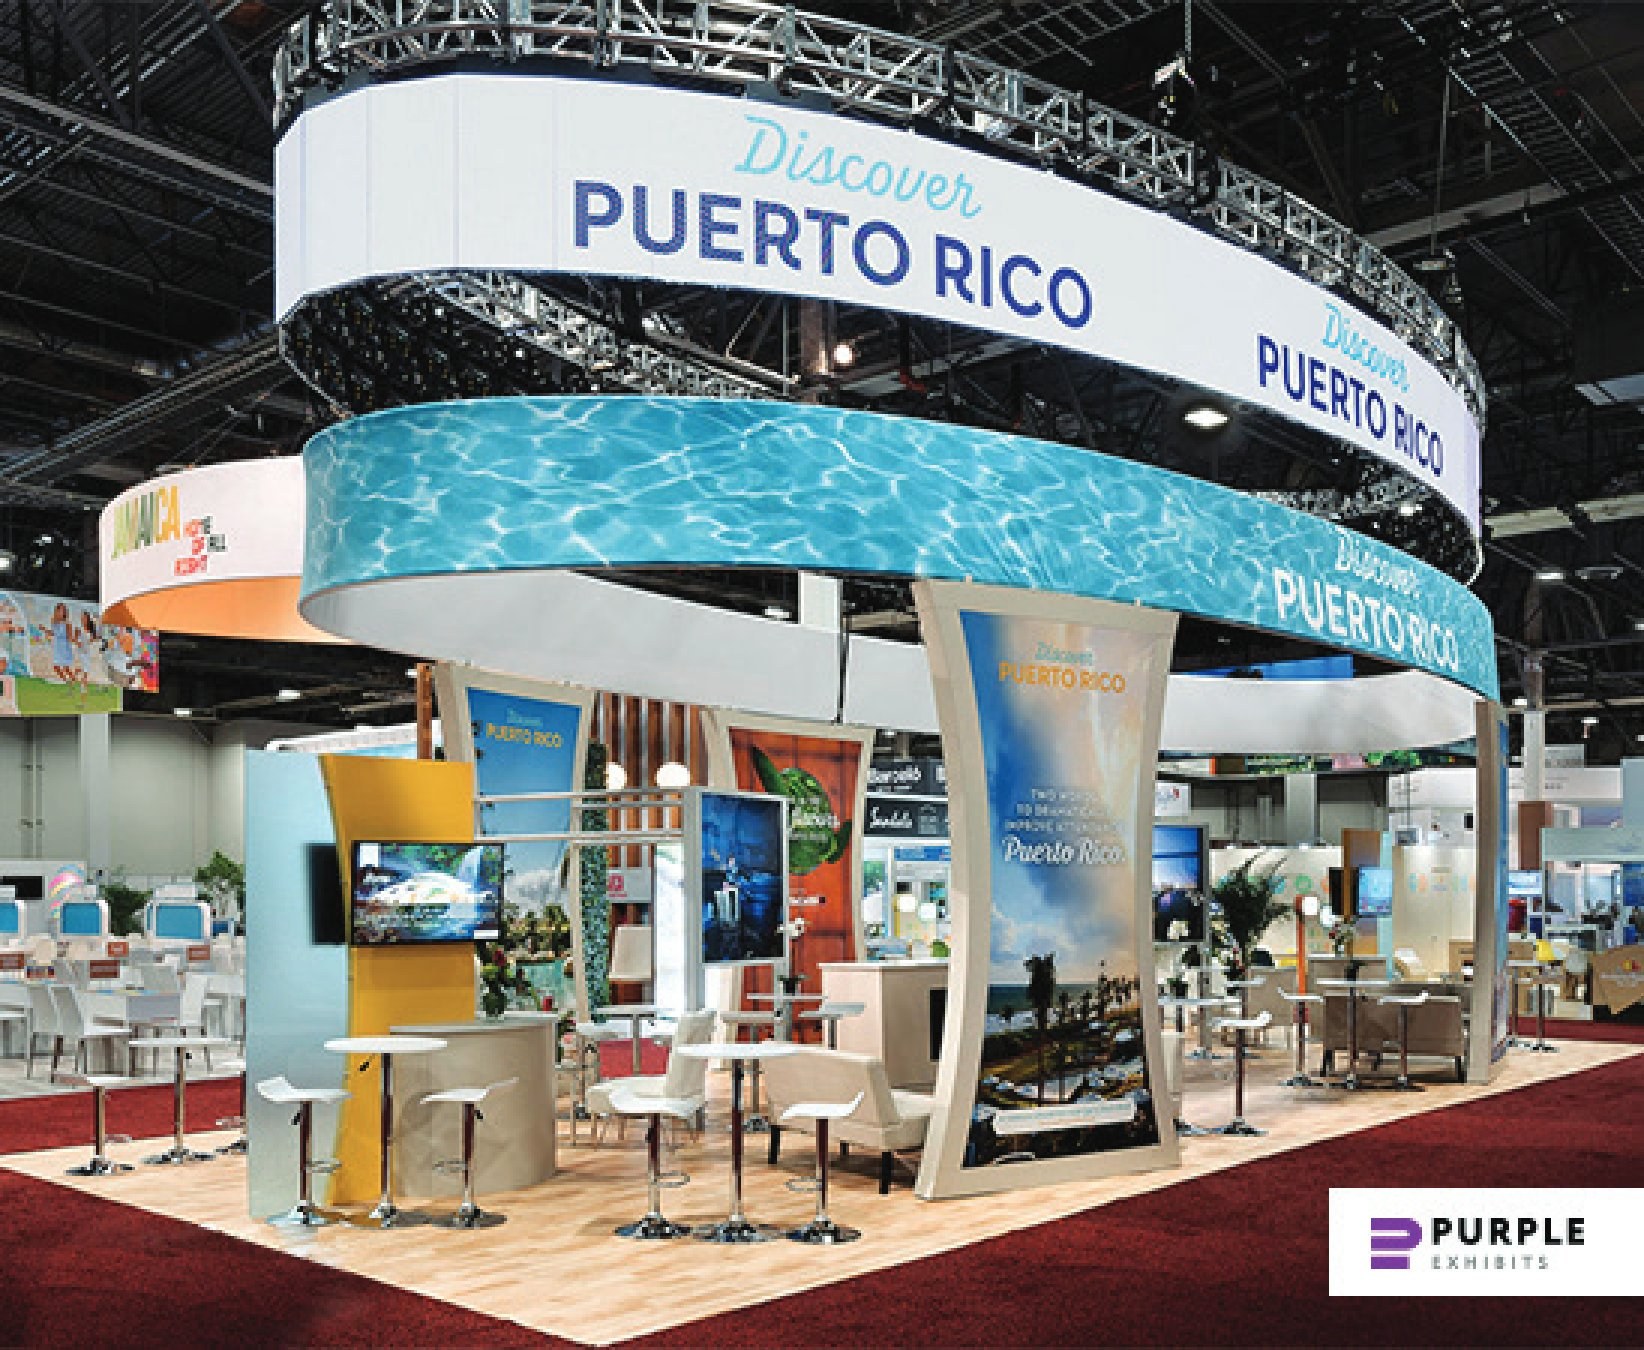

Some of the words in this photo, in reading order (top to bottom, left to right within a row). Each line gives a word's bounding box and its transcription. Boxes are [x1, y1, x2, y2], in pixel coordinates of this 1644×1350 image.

[734, 114, 981, 217] Discover
[573, 180, 912, 286] PUERTO
[935, 233, 1093, 329] RICO
[1322, 302, 1411, 393] Discover
[1257, 332, 1387, 439] PUERTO
[1394, 402, 1444, 477] RICO
[1272, 566, 1405, 653] PUERTO
[1407, 611, 1459, 673] RICO
[998, 661, 1077, 689] PUERTO
[1079, 670, 1126, 694] RICO
[1002, 834, 1075, 865] Puerto
